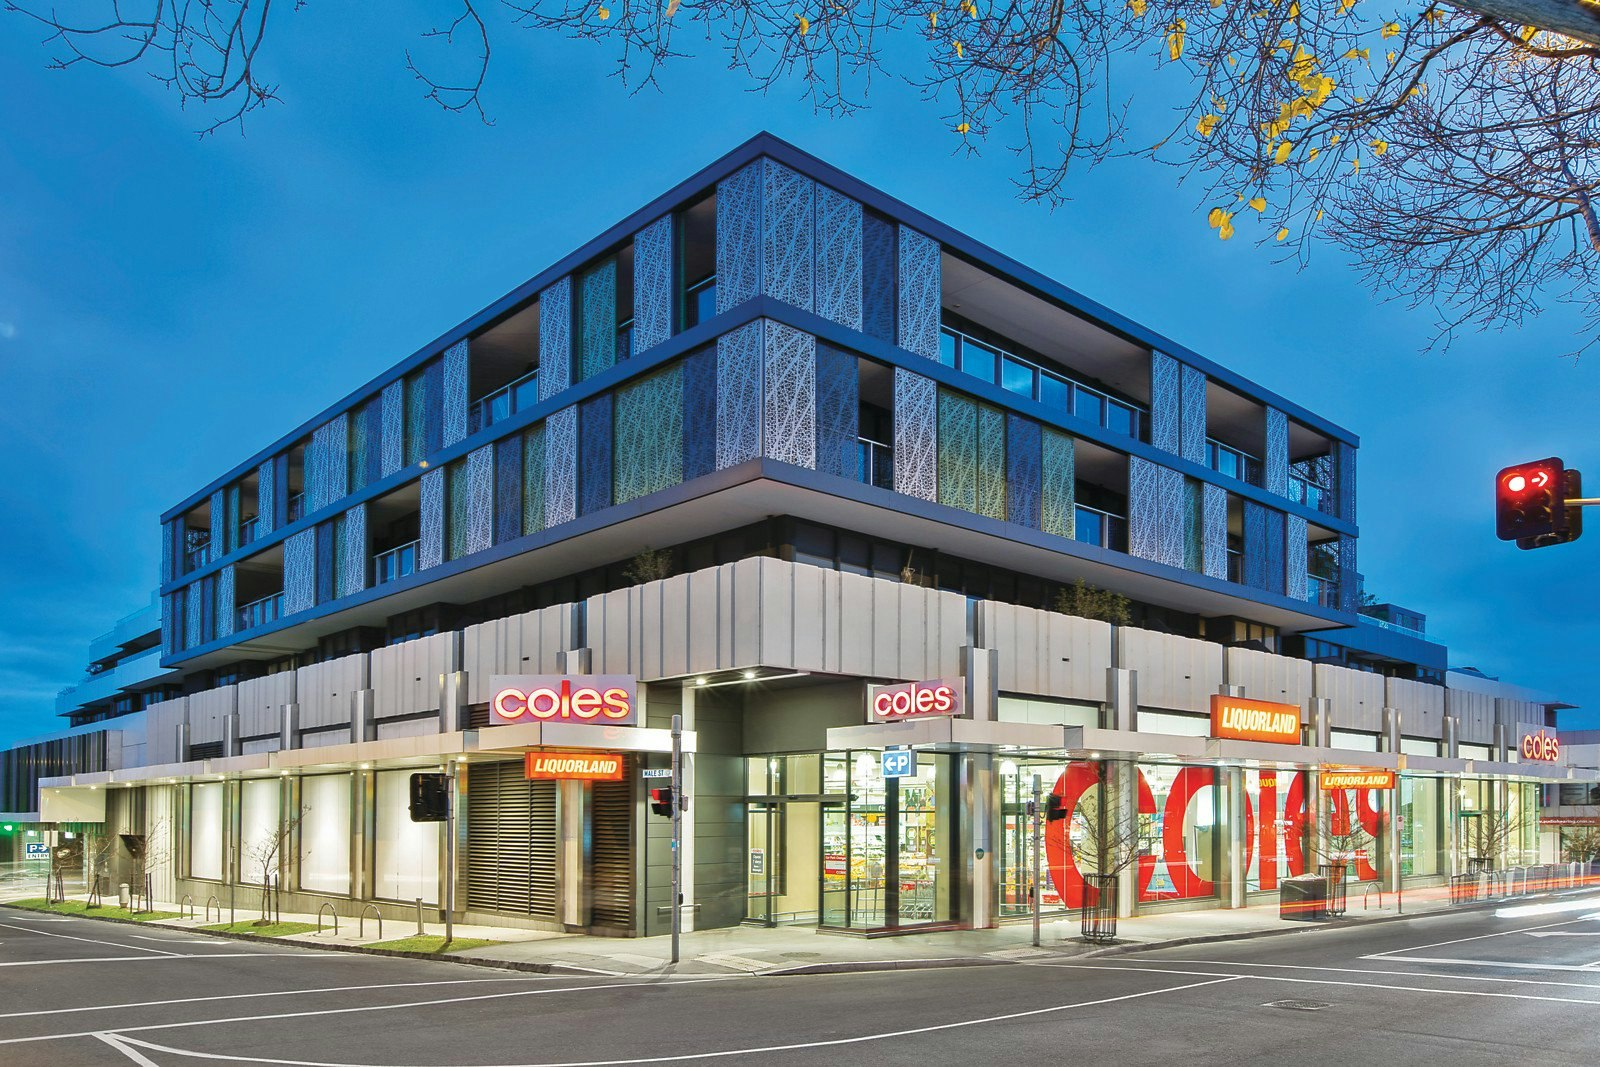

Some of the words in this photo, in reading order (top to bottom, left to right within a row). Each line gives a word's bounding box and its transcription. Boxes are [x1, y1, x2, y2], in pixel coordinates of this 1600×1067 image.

[494, 680, 630, 719] coles
[874, 683, 951, 716] coles
[1222, 707, 1296, 734] LIQUORLAND
[1523, 729, 1559, 761] coles
[535, 758, 617, 774] LIQUORLAND
[1325, 775, 1389, 787] LIQUORLAND
